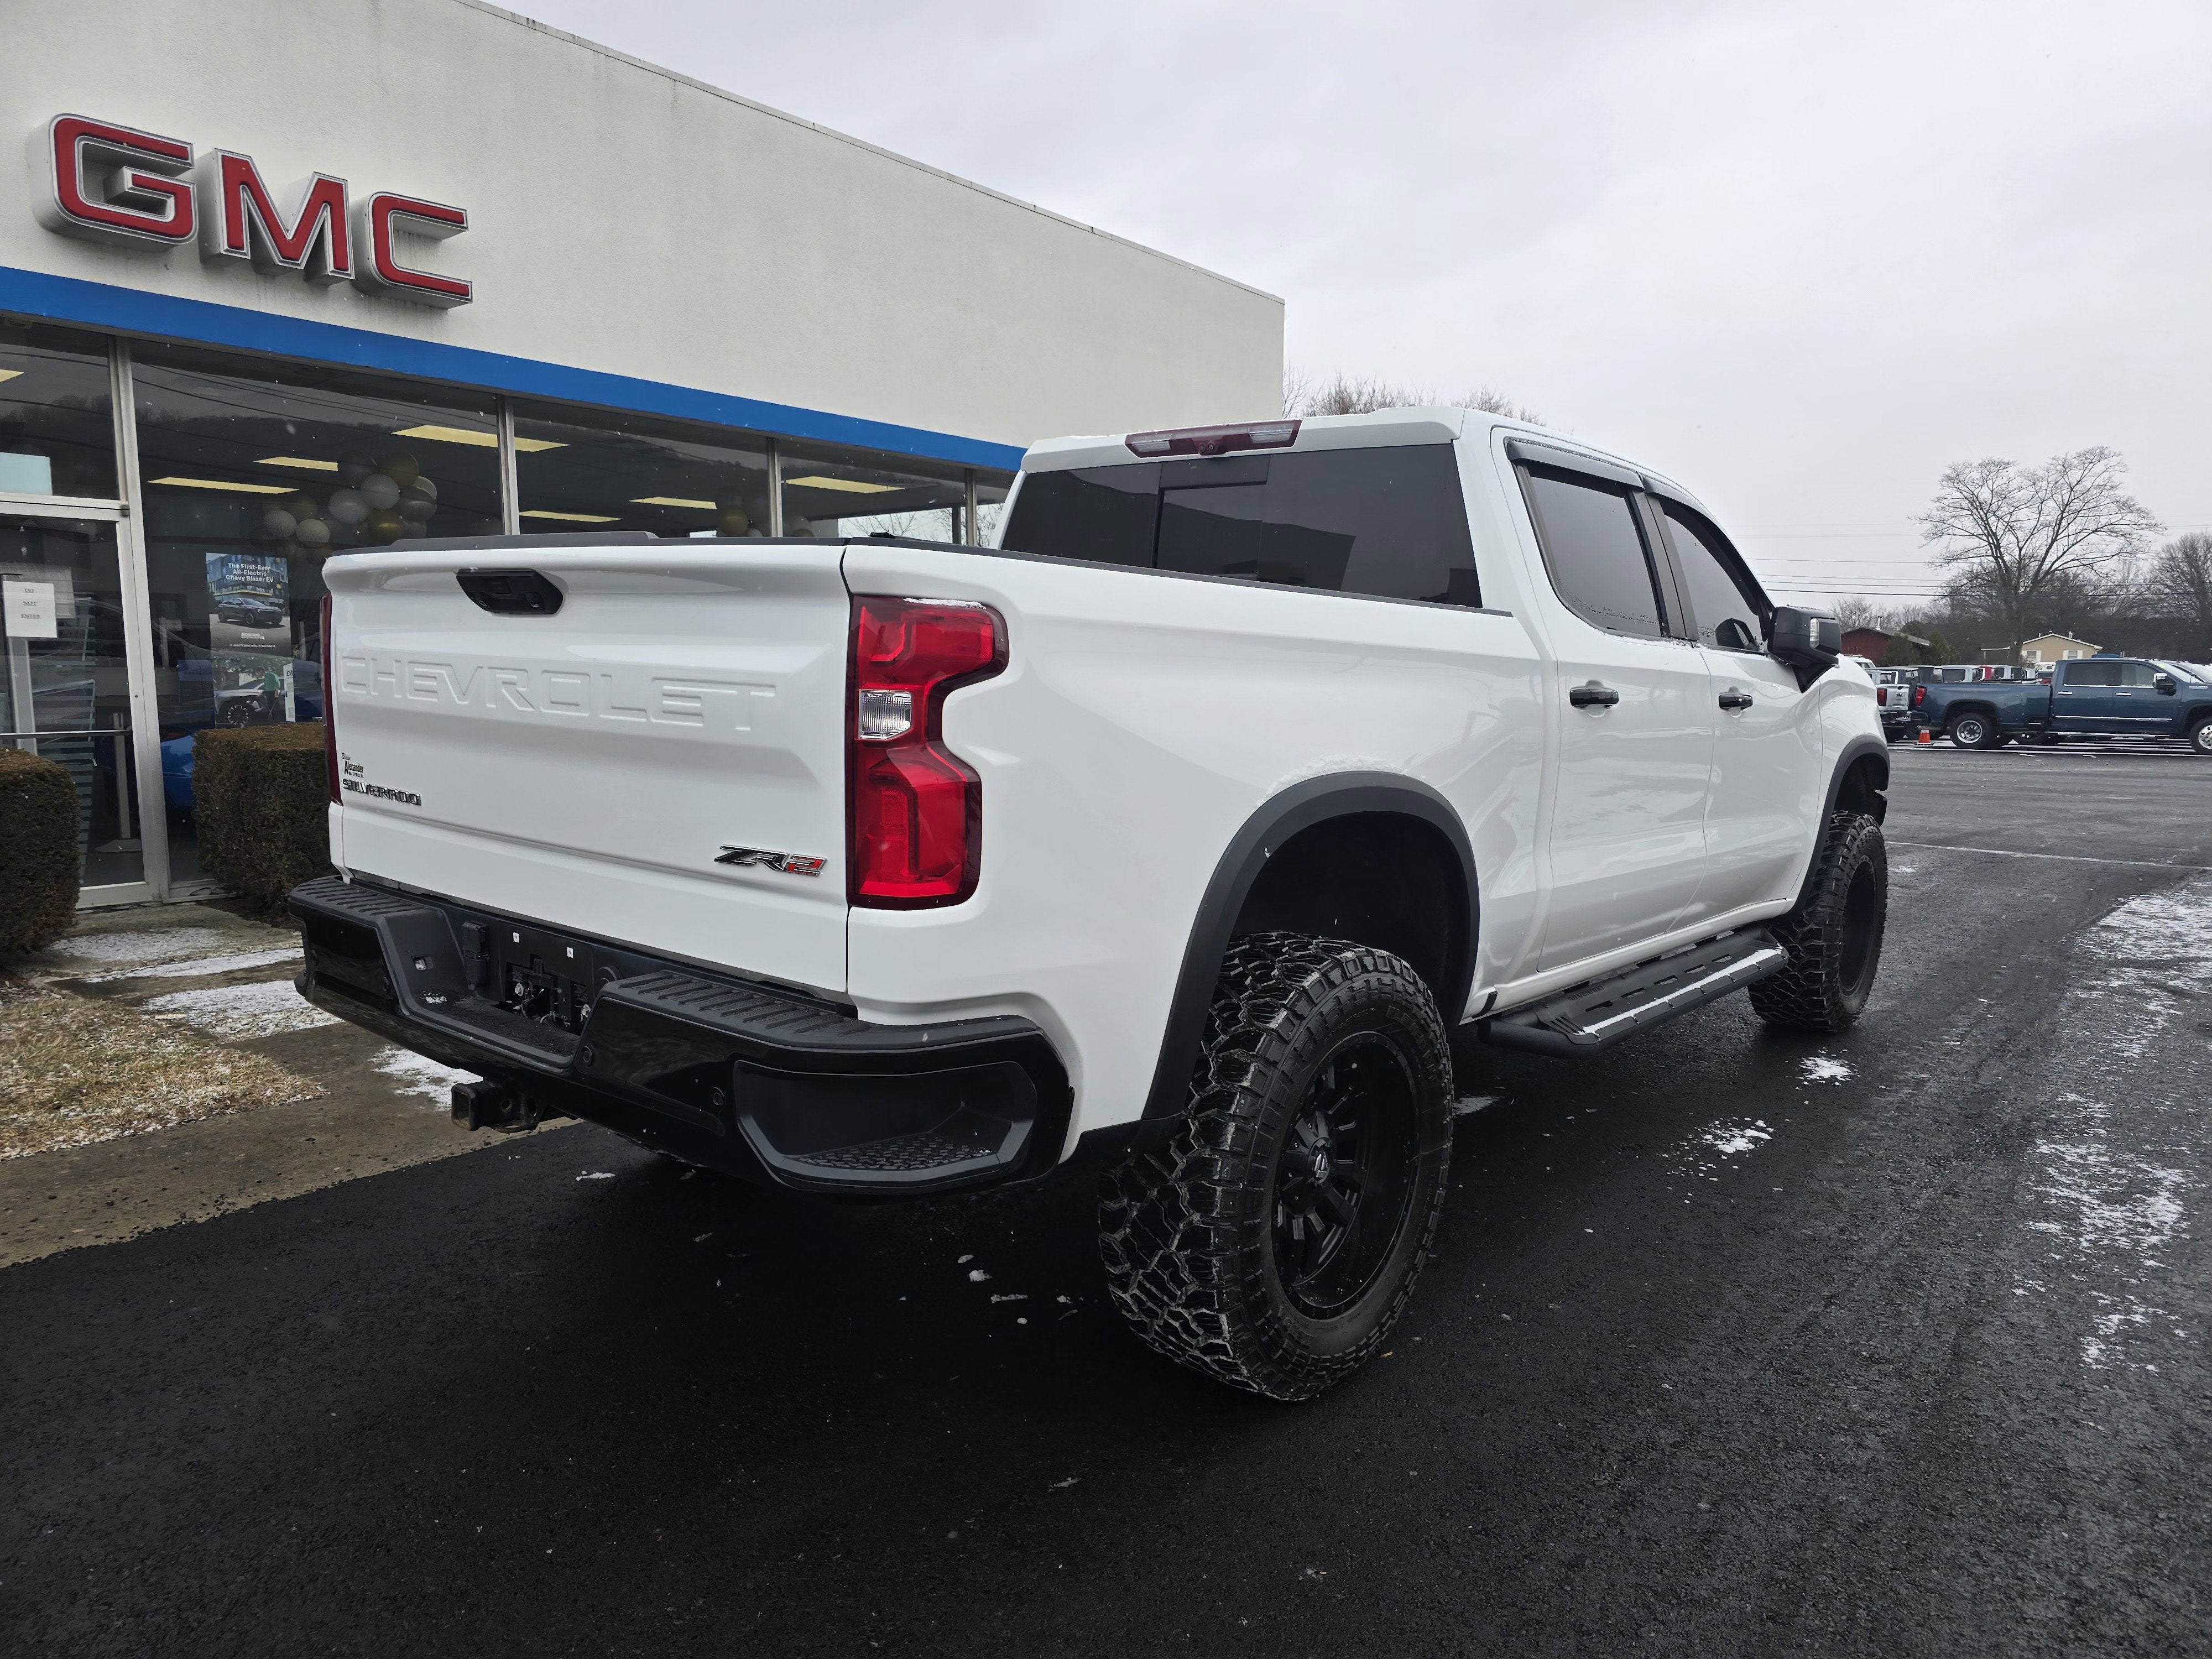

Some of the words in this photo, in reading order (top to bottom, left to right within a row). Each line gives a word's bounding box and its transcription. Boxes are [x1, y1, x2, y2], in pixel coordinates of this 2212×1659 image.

[44, 112, 474, 305] GMC
[341, 656, 776, 731] CHEVROLET
[342, 778, 422, 806] SILVERADO
[714, 844, 828, 877] ZR2
